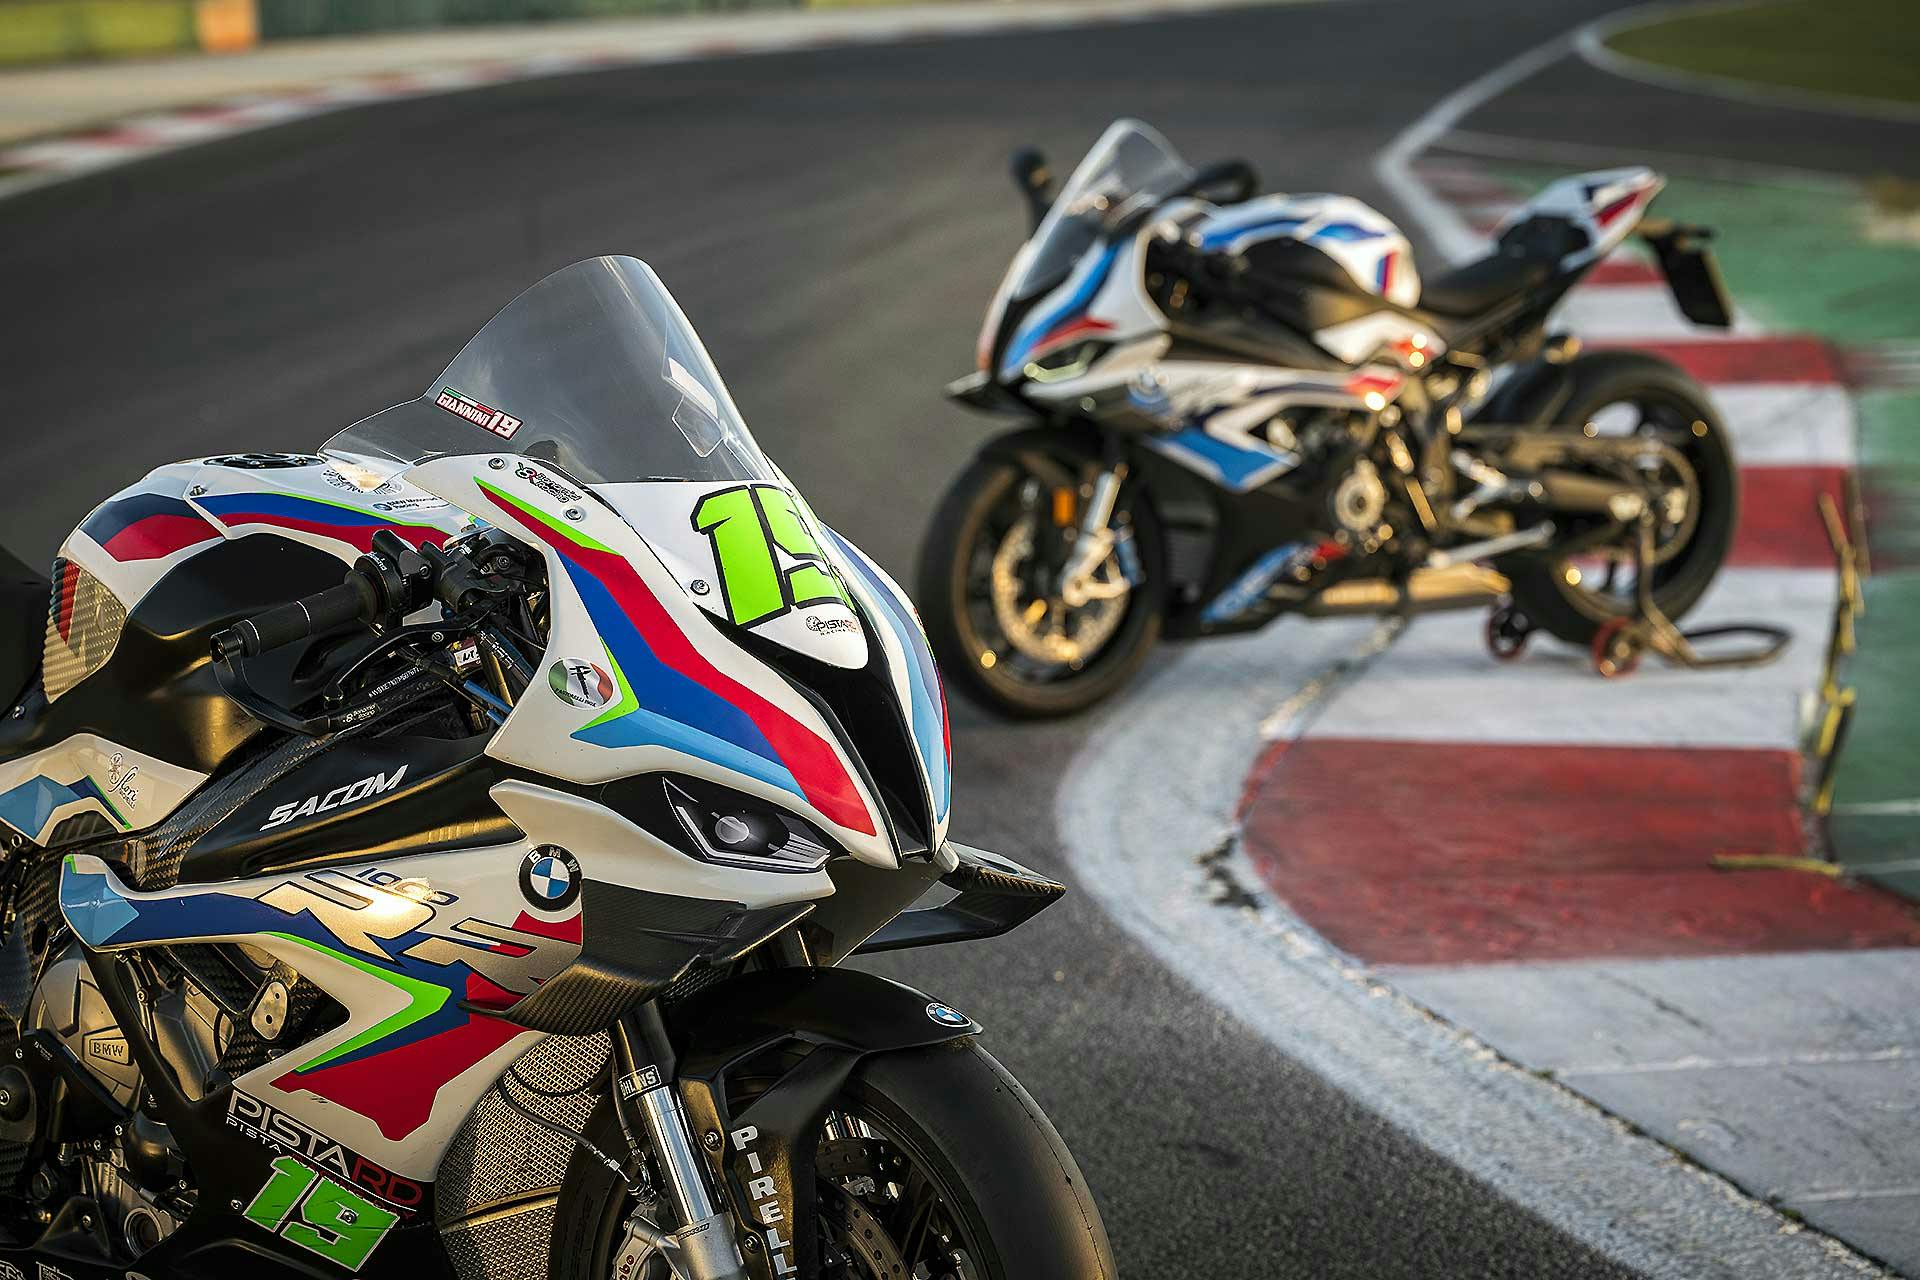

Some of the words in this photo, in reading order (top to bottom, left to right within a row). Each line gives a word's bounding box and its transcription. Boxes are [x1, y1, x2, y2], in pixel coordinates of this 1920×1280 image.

[437, 393, 491, 426] GIANNINI
[487, 411, 522, 438] 19
[690, 484, 857, 630] 19
[260, 764, 409, 832] SACOM
[527, 846, 580, 873] BMW
[93, 1041, 124, 1057] BMW
[225, 1116, 282, 1155] PISTA
[228, 1089, 423, 1206] PISTARD
[243, 1155, 401, 1272] 19
[731, 1125, 797, 1280] PIRELL
